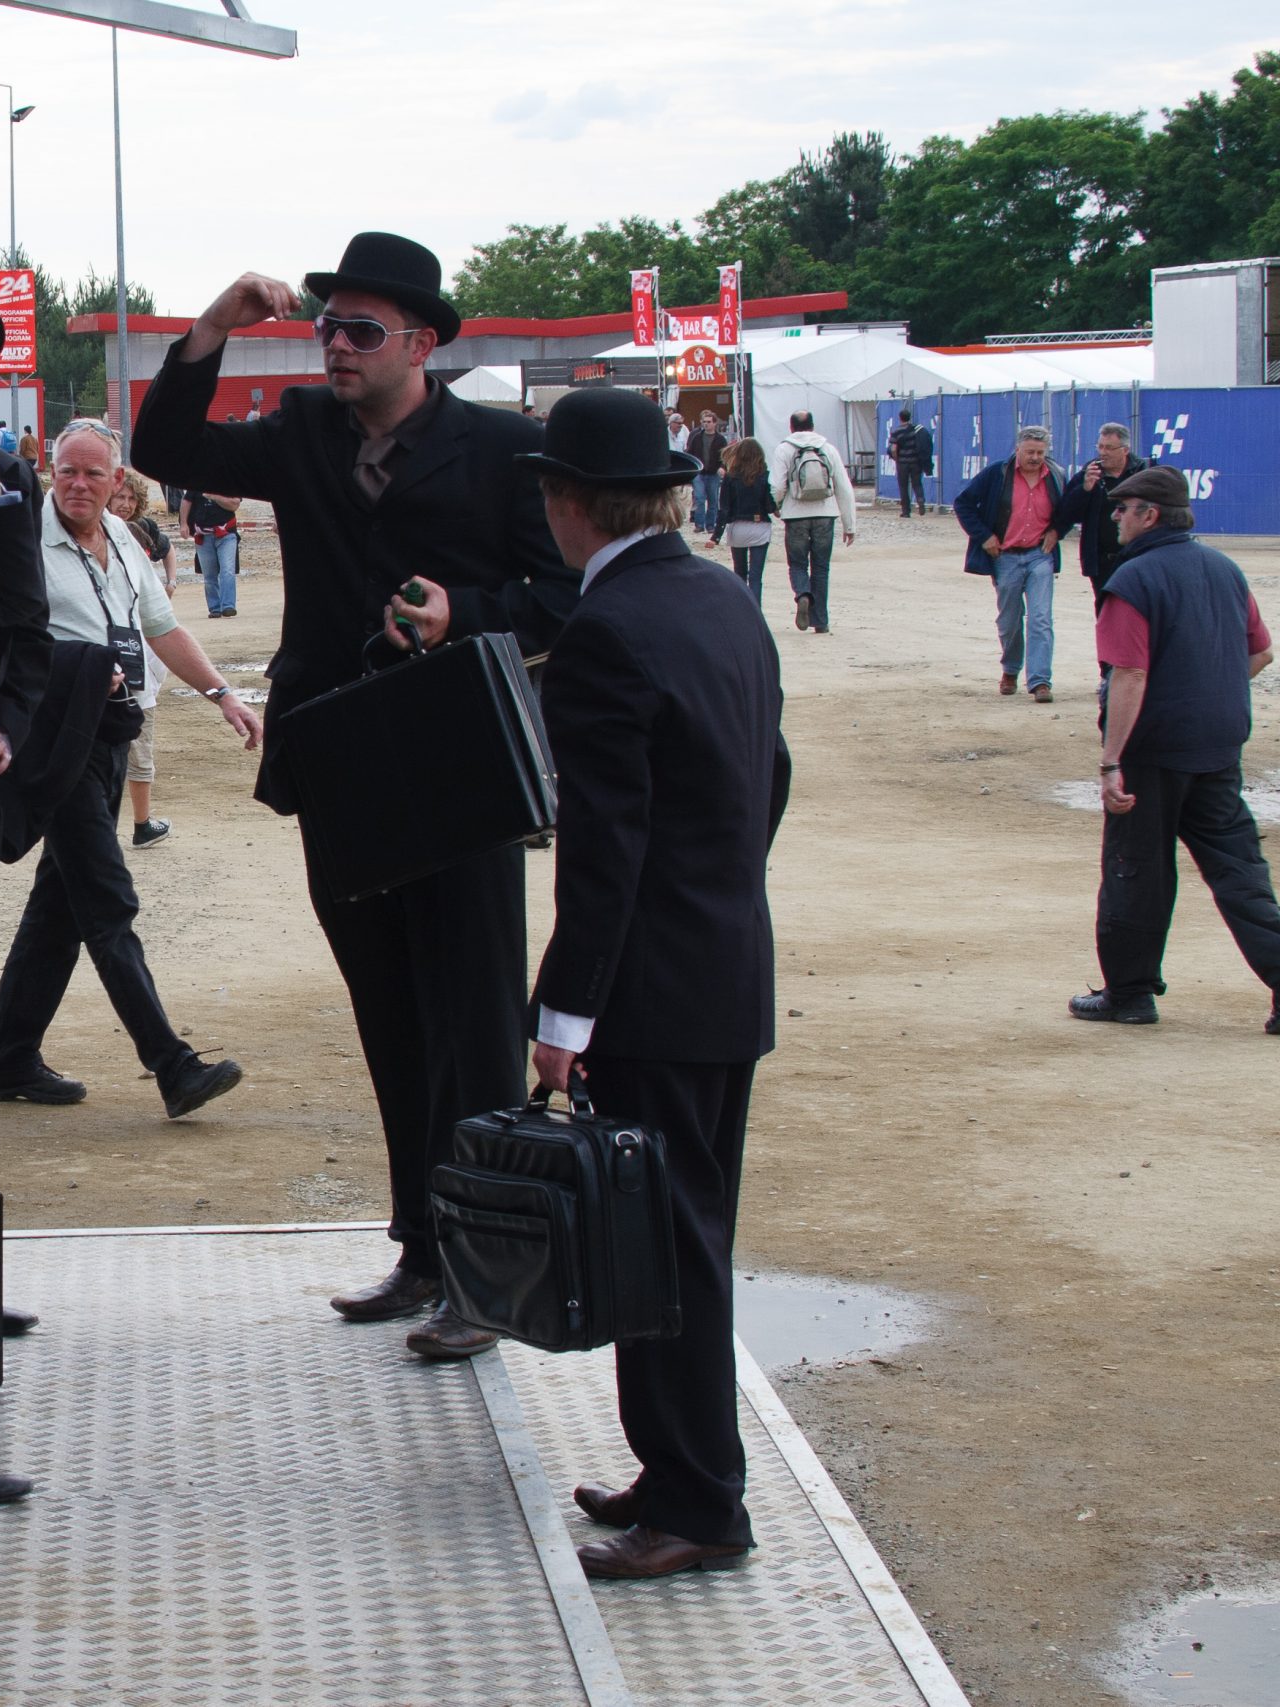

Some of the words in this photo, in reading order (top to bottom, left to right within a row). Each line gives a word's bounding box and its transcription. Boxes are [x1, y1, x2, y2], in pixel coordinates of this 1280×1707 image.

[636, 298, 648, 343] BAR
[684, 321, 700, 336] BAR
[722, 294, 733, 342] BAR
[687, 364, 715, 381] BAR
[1182, 469, 1215, 500] NS
